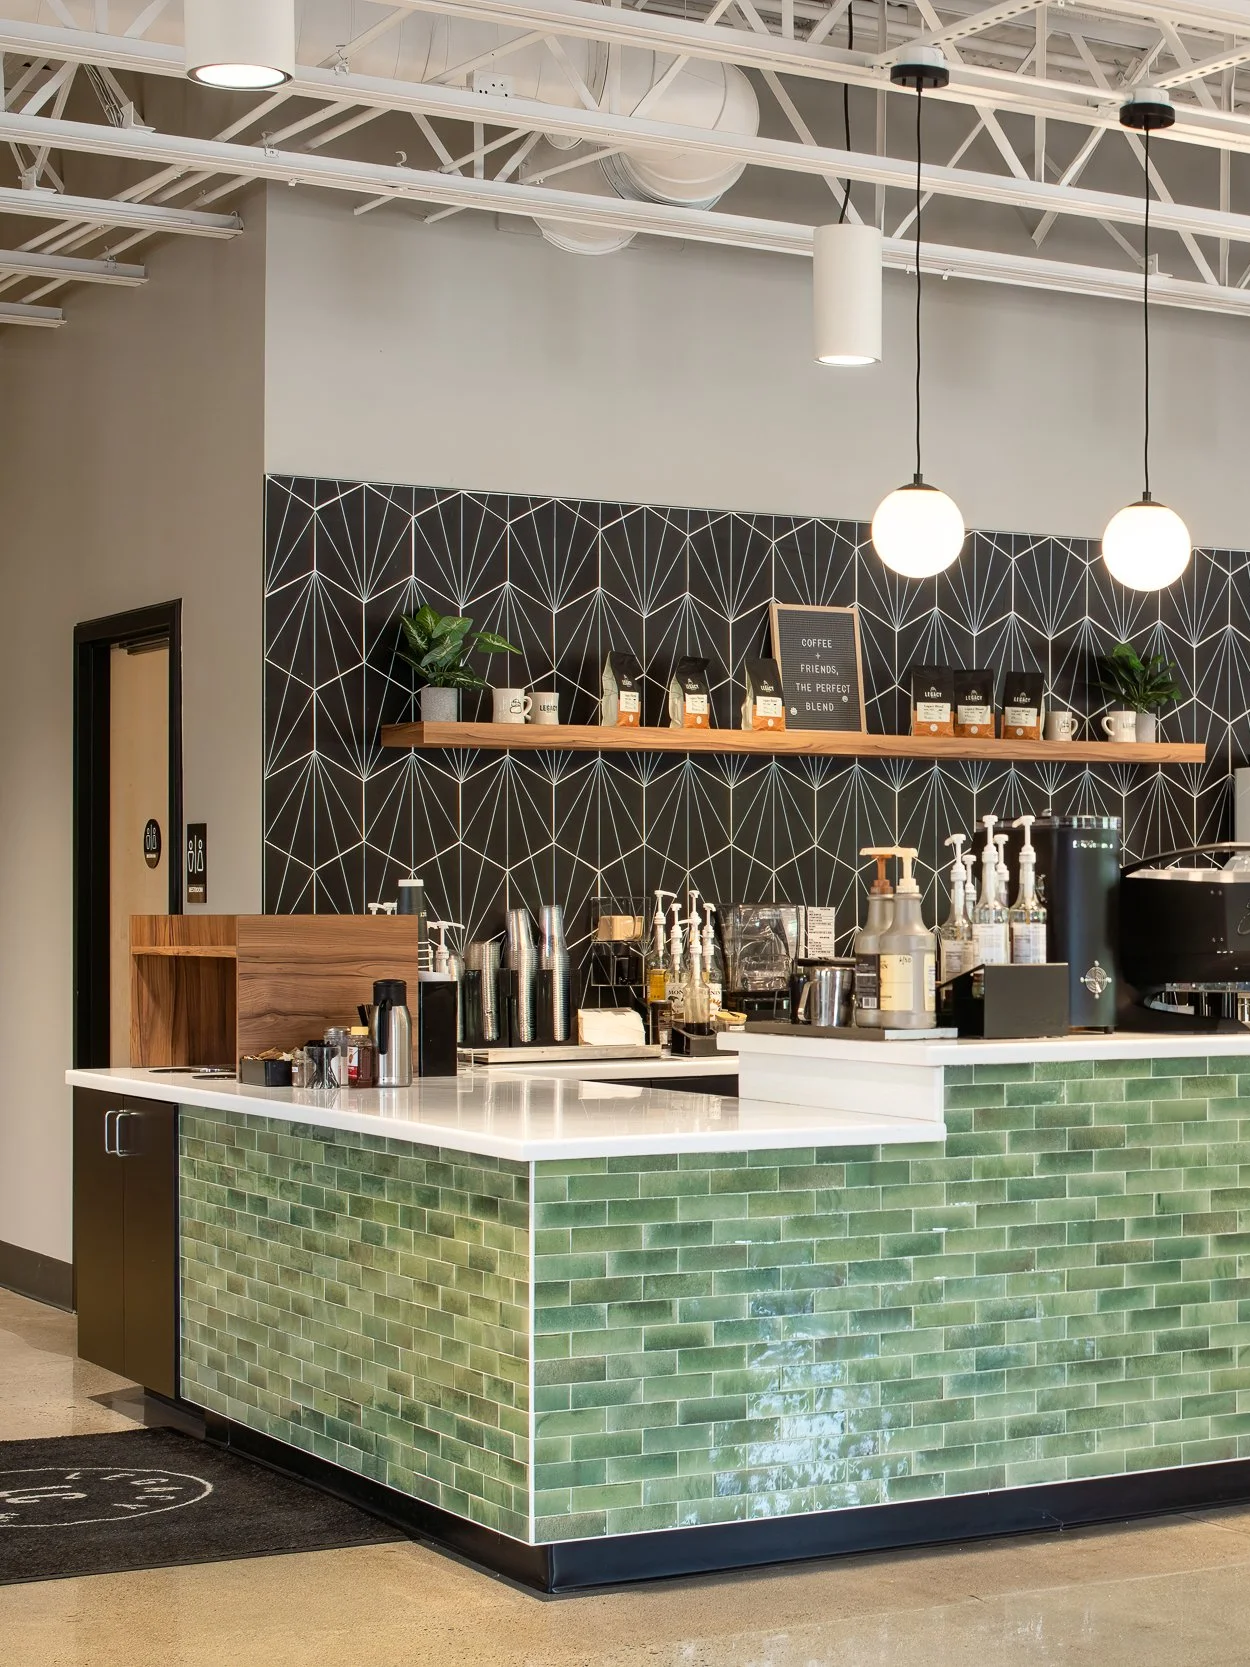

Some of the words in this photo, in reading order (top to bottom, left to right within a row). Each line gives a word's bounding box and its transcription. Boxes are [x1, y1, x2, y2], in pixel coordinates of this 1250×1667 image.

[801, 638, 832, 648] COFFEE
[800, 664, 839, 676] FRIENDS,
[796, 682, 812, 692] THE
[816, 683, 851, 693] PERFECT
[805, 702, 834, 712] BLEND
